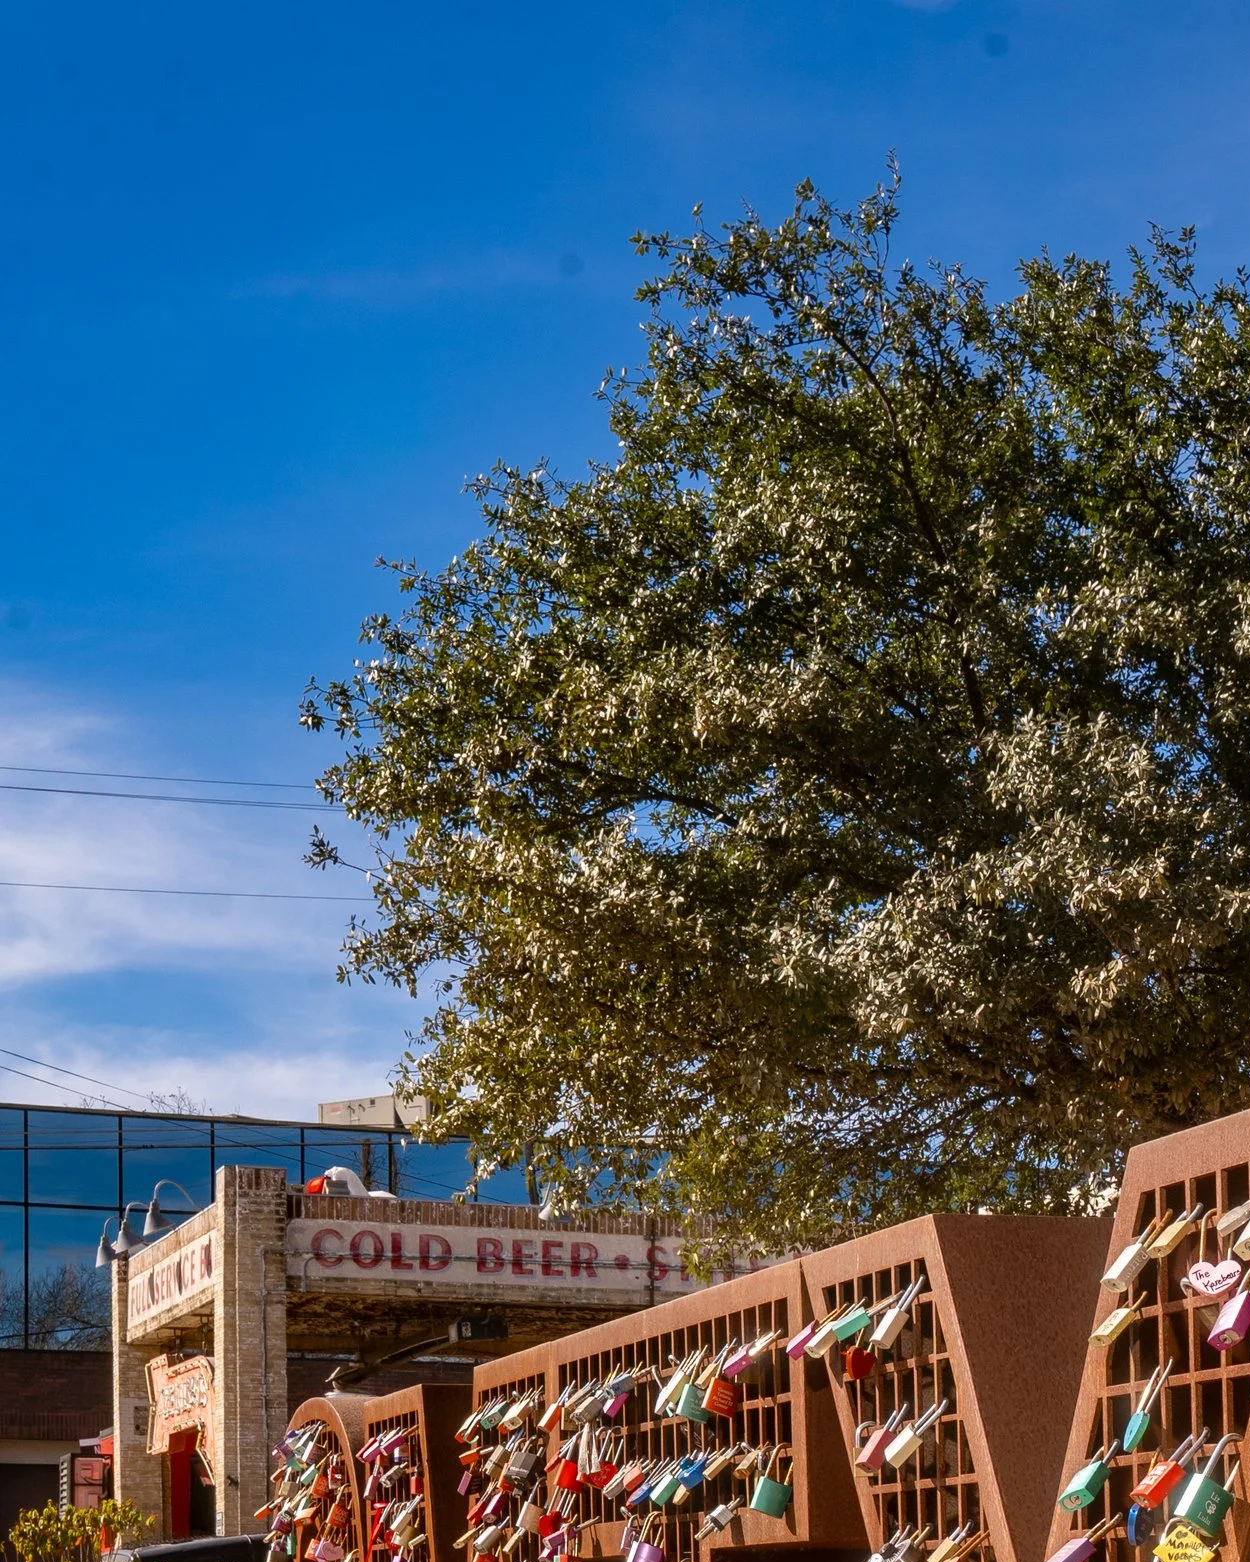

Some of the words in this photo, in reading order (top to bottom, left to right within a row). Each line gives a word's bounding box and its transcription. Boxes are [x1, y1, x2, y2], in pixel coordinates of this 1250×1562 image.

[311, 1228, 452, 1271] COLD
[476, 1237, 598, 1278] BEER
[1192, 1269, 1210, 1280] The
[1210, 1491, 1221, 1504] Liz
